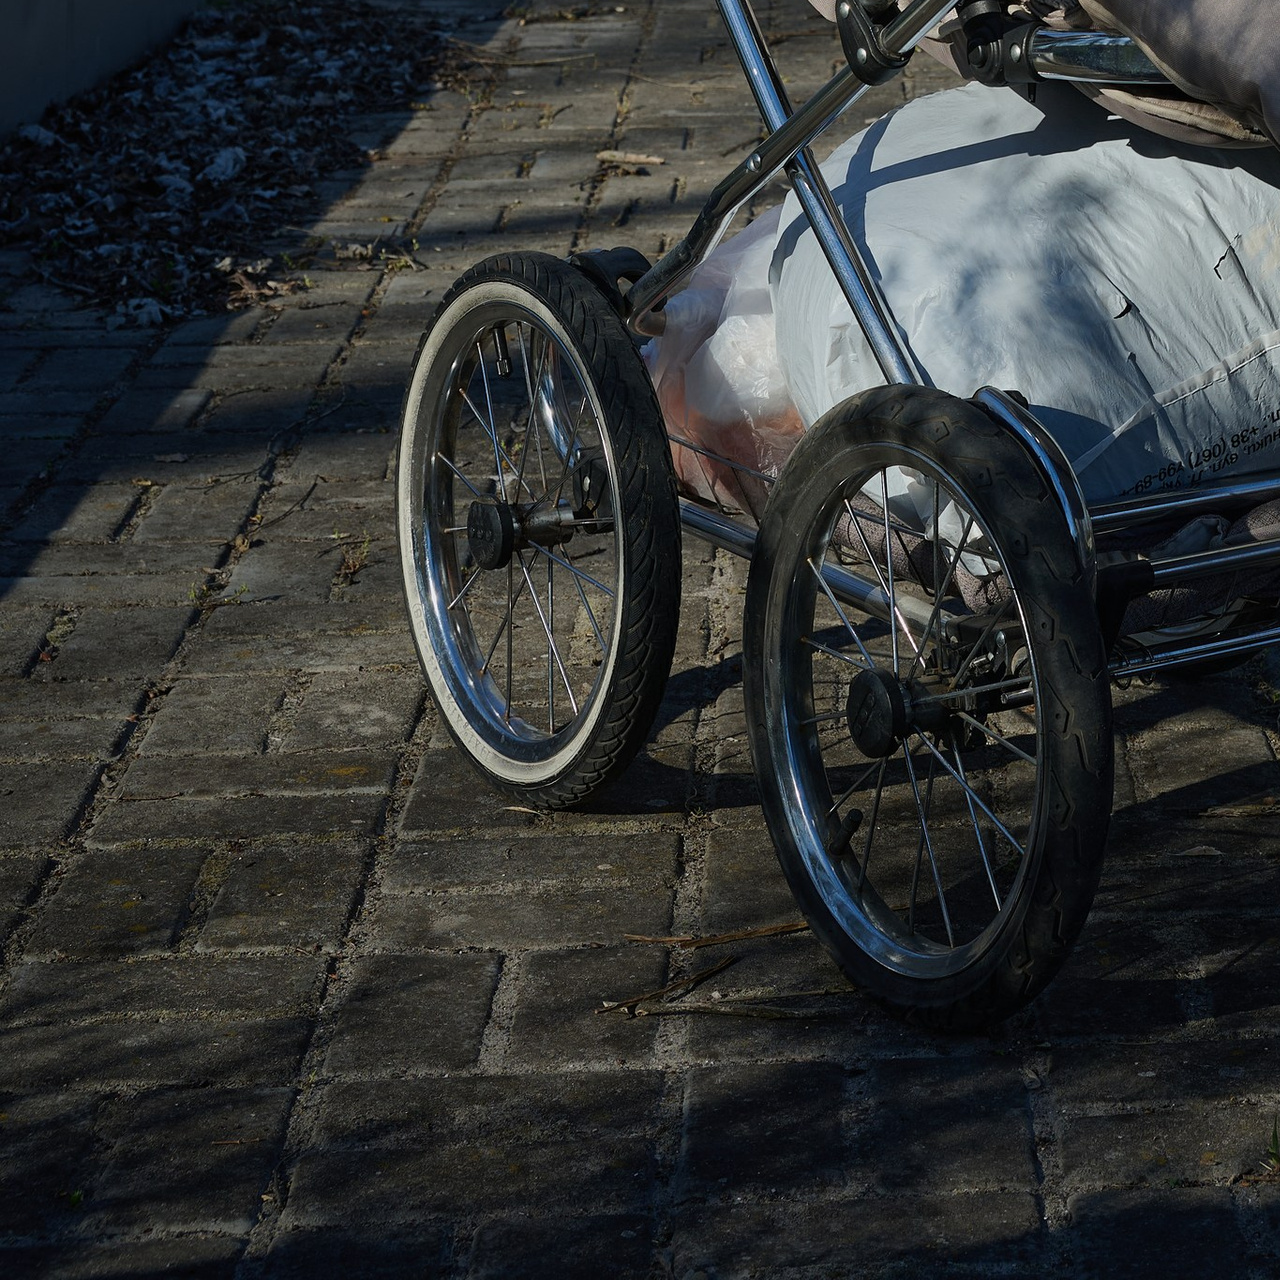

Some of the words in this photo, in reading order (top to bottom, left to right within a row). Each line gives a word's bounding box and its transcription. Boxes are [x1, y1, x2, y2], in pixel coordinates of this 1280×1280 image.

[1230, 425, 1260, 448] +38
[1188, 437, 1226, 470] (067)
[1208, 452, 1239, 473] вул.
